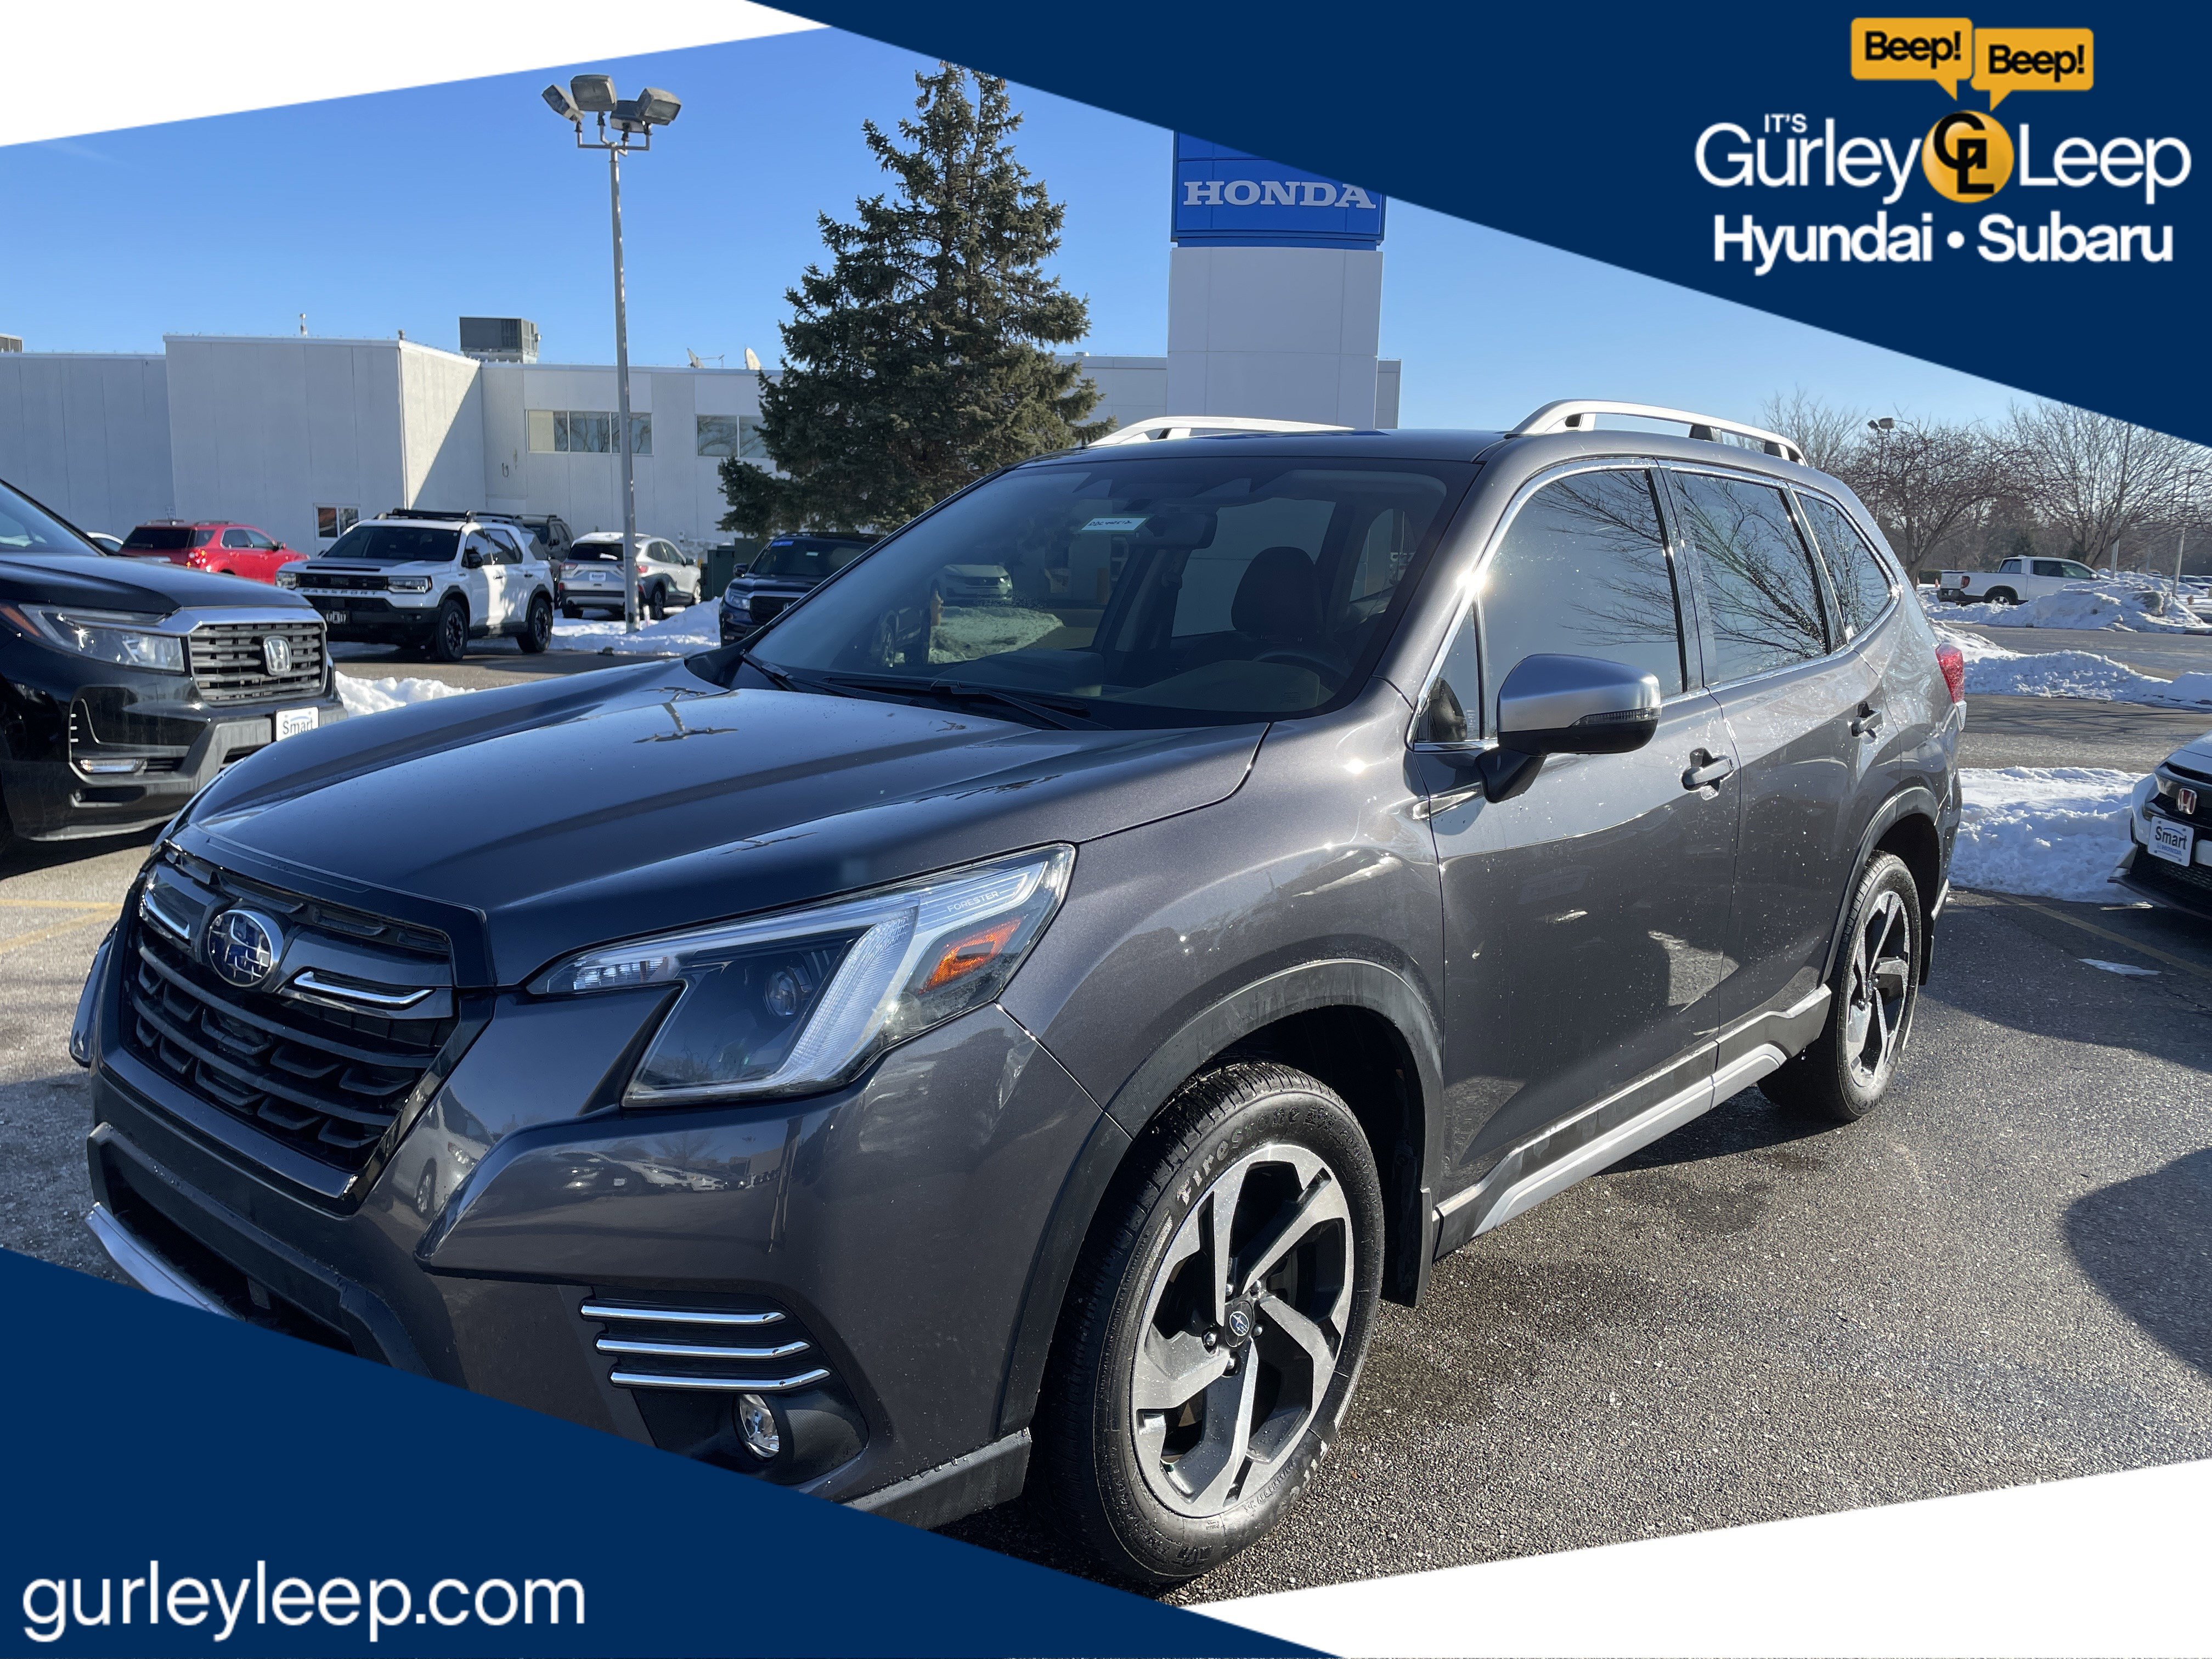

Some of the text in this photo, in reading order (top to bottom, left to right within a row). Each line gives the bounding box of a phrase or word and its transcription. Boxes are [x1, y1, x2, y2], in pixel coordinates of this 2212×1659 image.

[1183, 180, 1376, 209] HONDA
[283, 716, 313, 735] Smart
[2154, 825, 2187, 850] Smart
[947, 890, 999, 912] FORESTER
